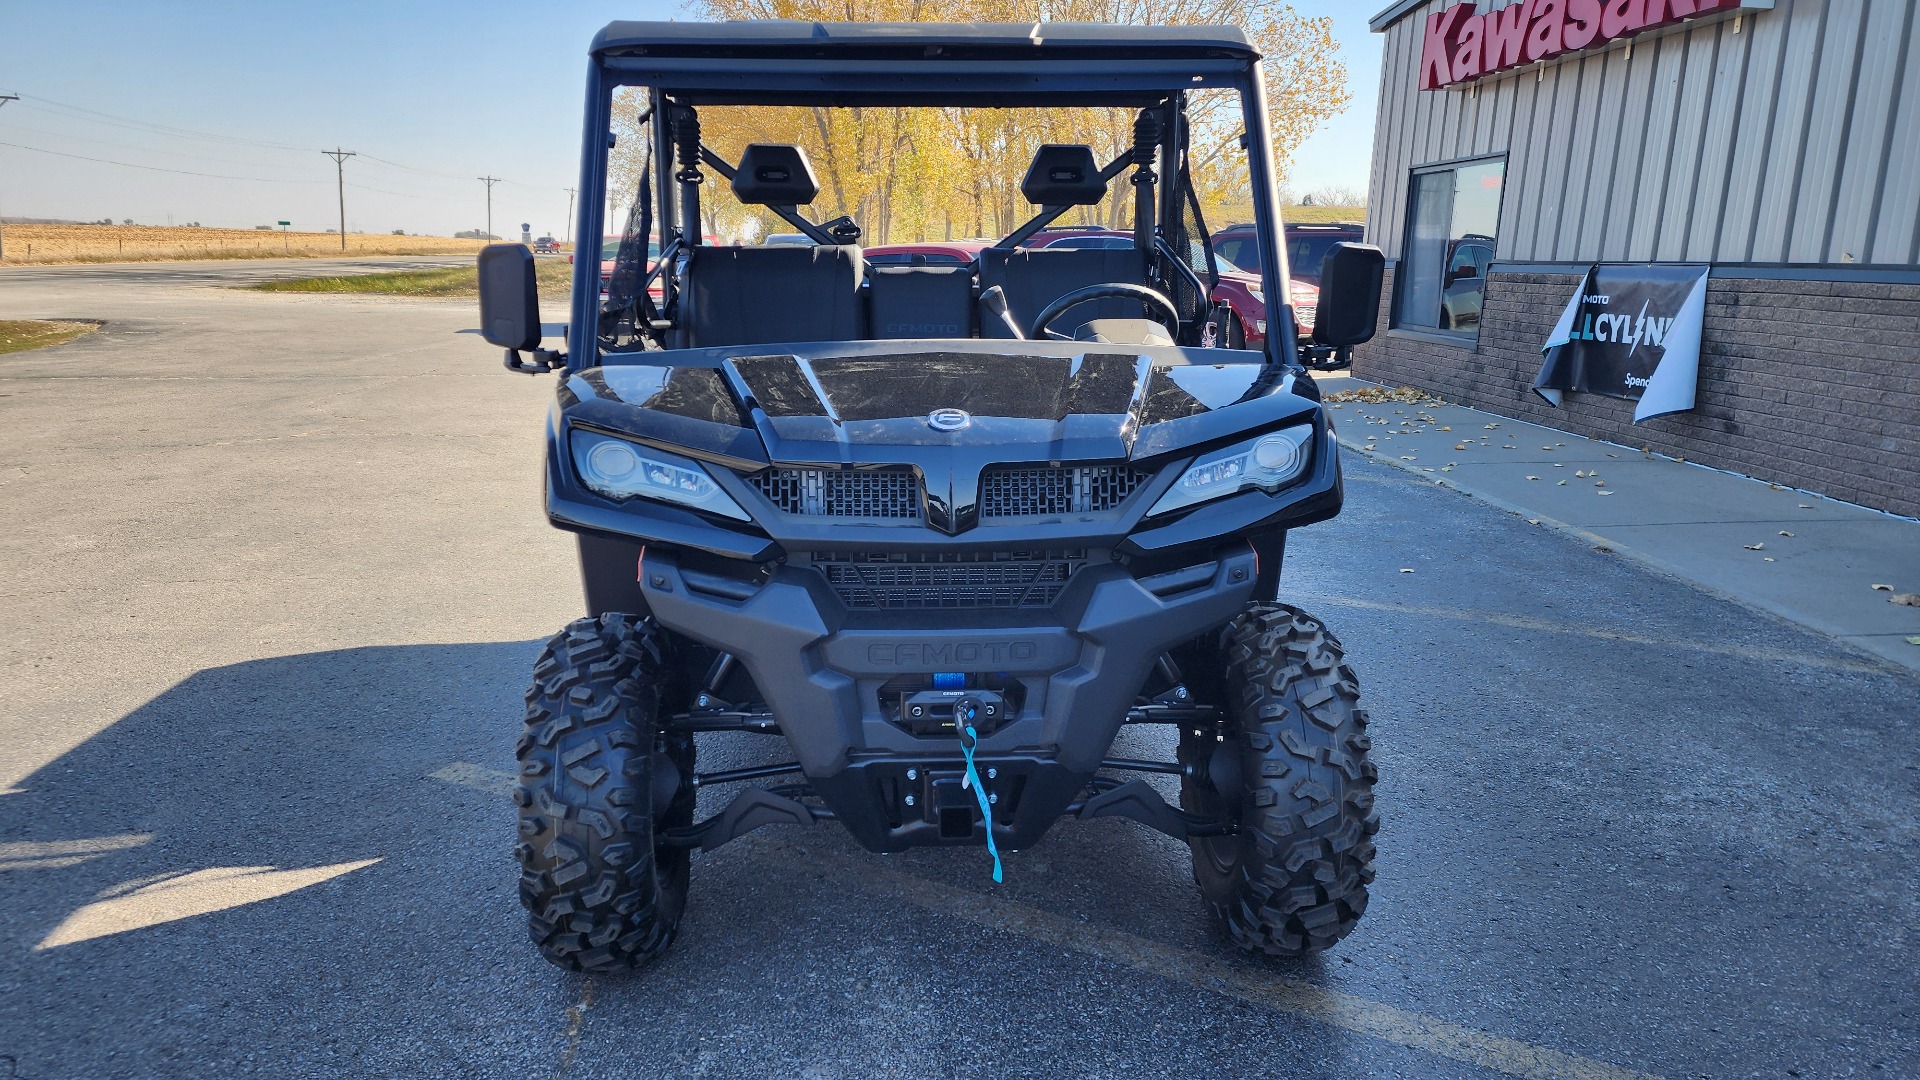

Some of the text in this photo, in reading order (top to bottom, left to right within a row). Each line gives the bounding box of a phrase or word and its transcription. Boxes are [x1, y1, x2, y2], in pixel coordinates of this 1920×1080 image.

[1419, 0, 1720, 91] Kawasa
[887, 324, 958, 334] CFMOTO
[867, 642, 1036, 665] CFMOTO
